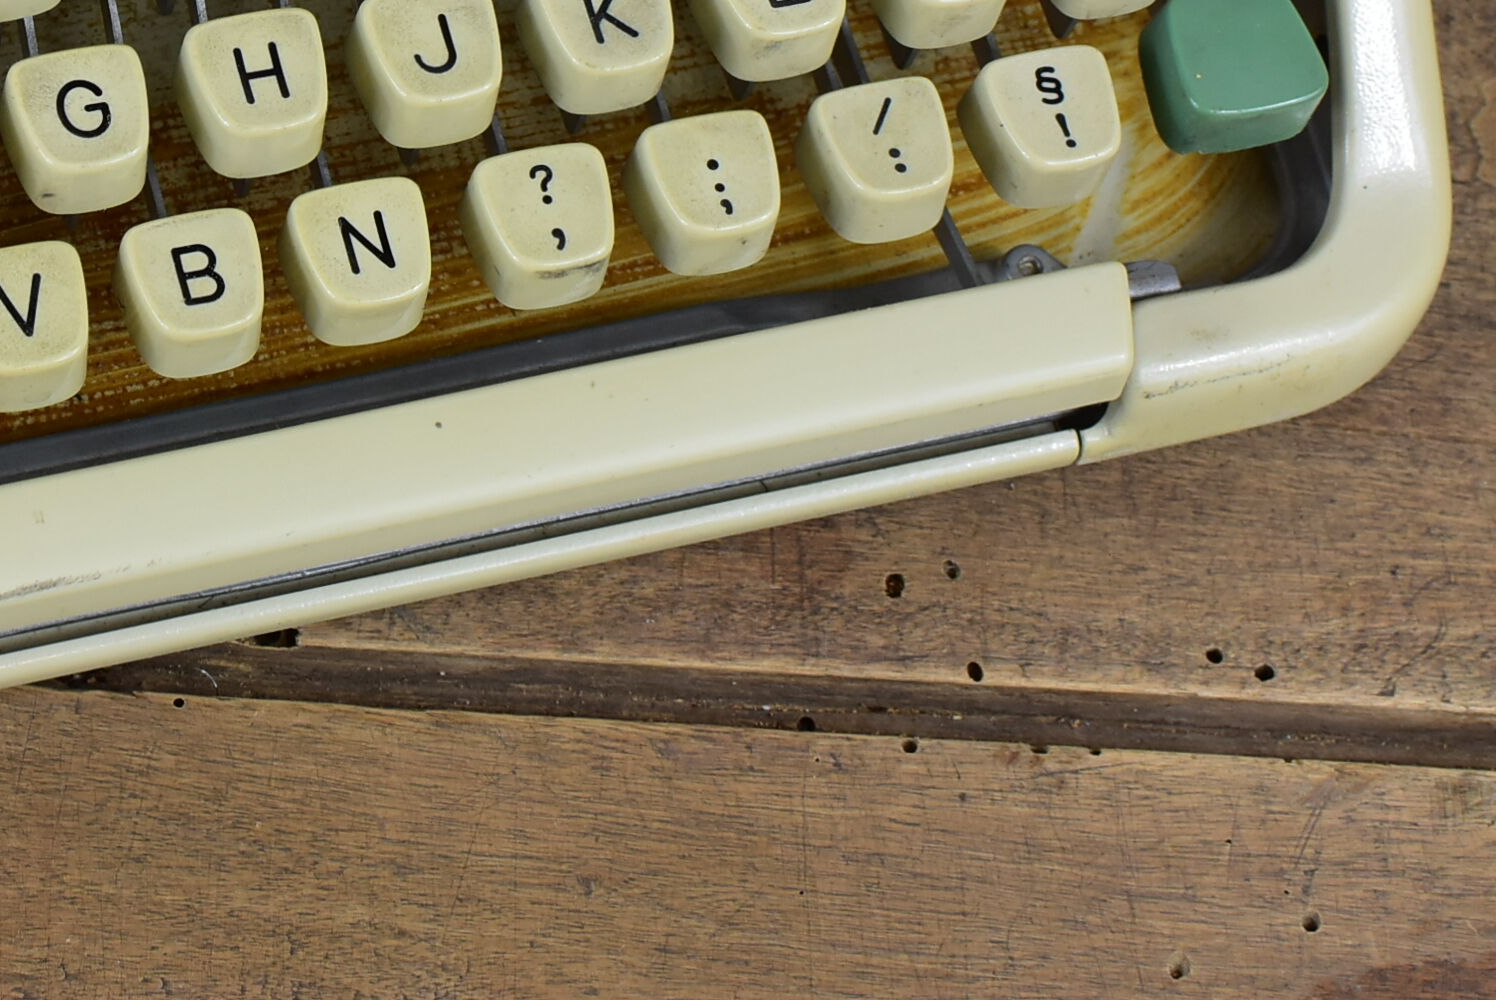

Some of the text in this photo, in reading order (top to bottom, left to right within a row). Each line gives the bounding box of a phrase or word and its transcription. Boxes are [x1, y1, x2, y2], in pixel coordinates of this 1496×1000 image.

[232, 41, 291, 105] H
[413, 13, 458, 74] J
[55, 79, 112, 139] G
[1034, 66, 1065, 105] §
[1055, 112, 1077, 148] !
[529, 164, 553, 205] ?
[337, 210, 396, 275] N
[170, 243, 226, 306] B
